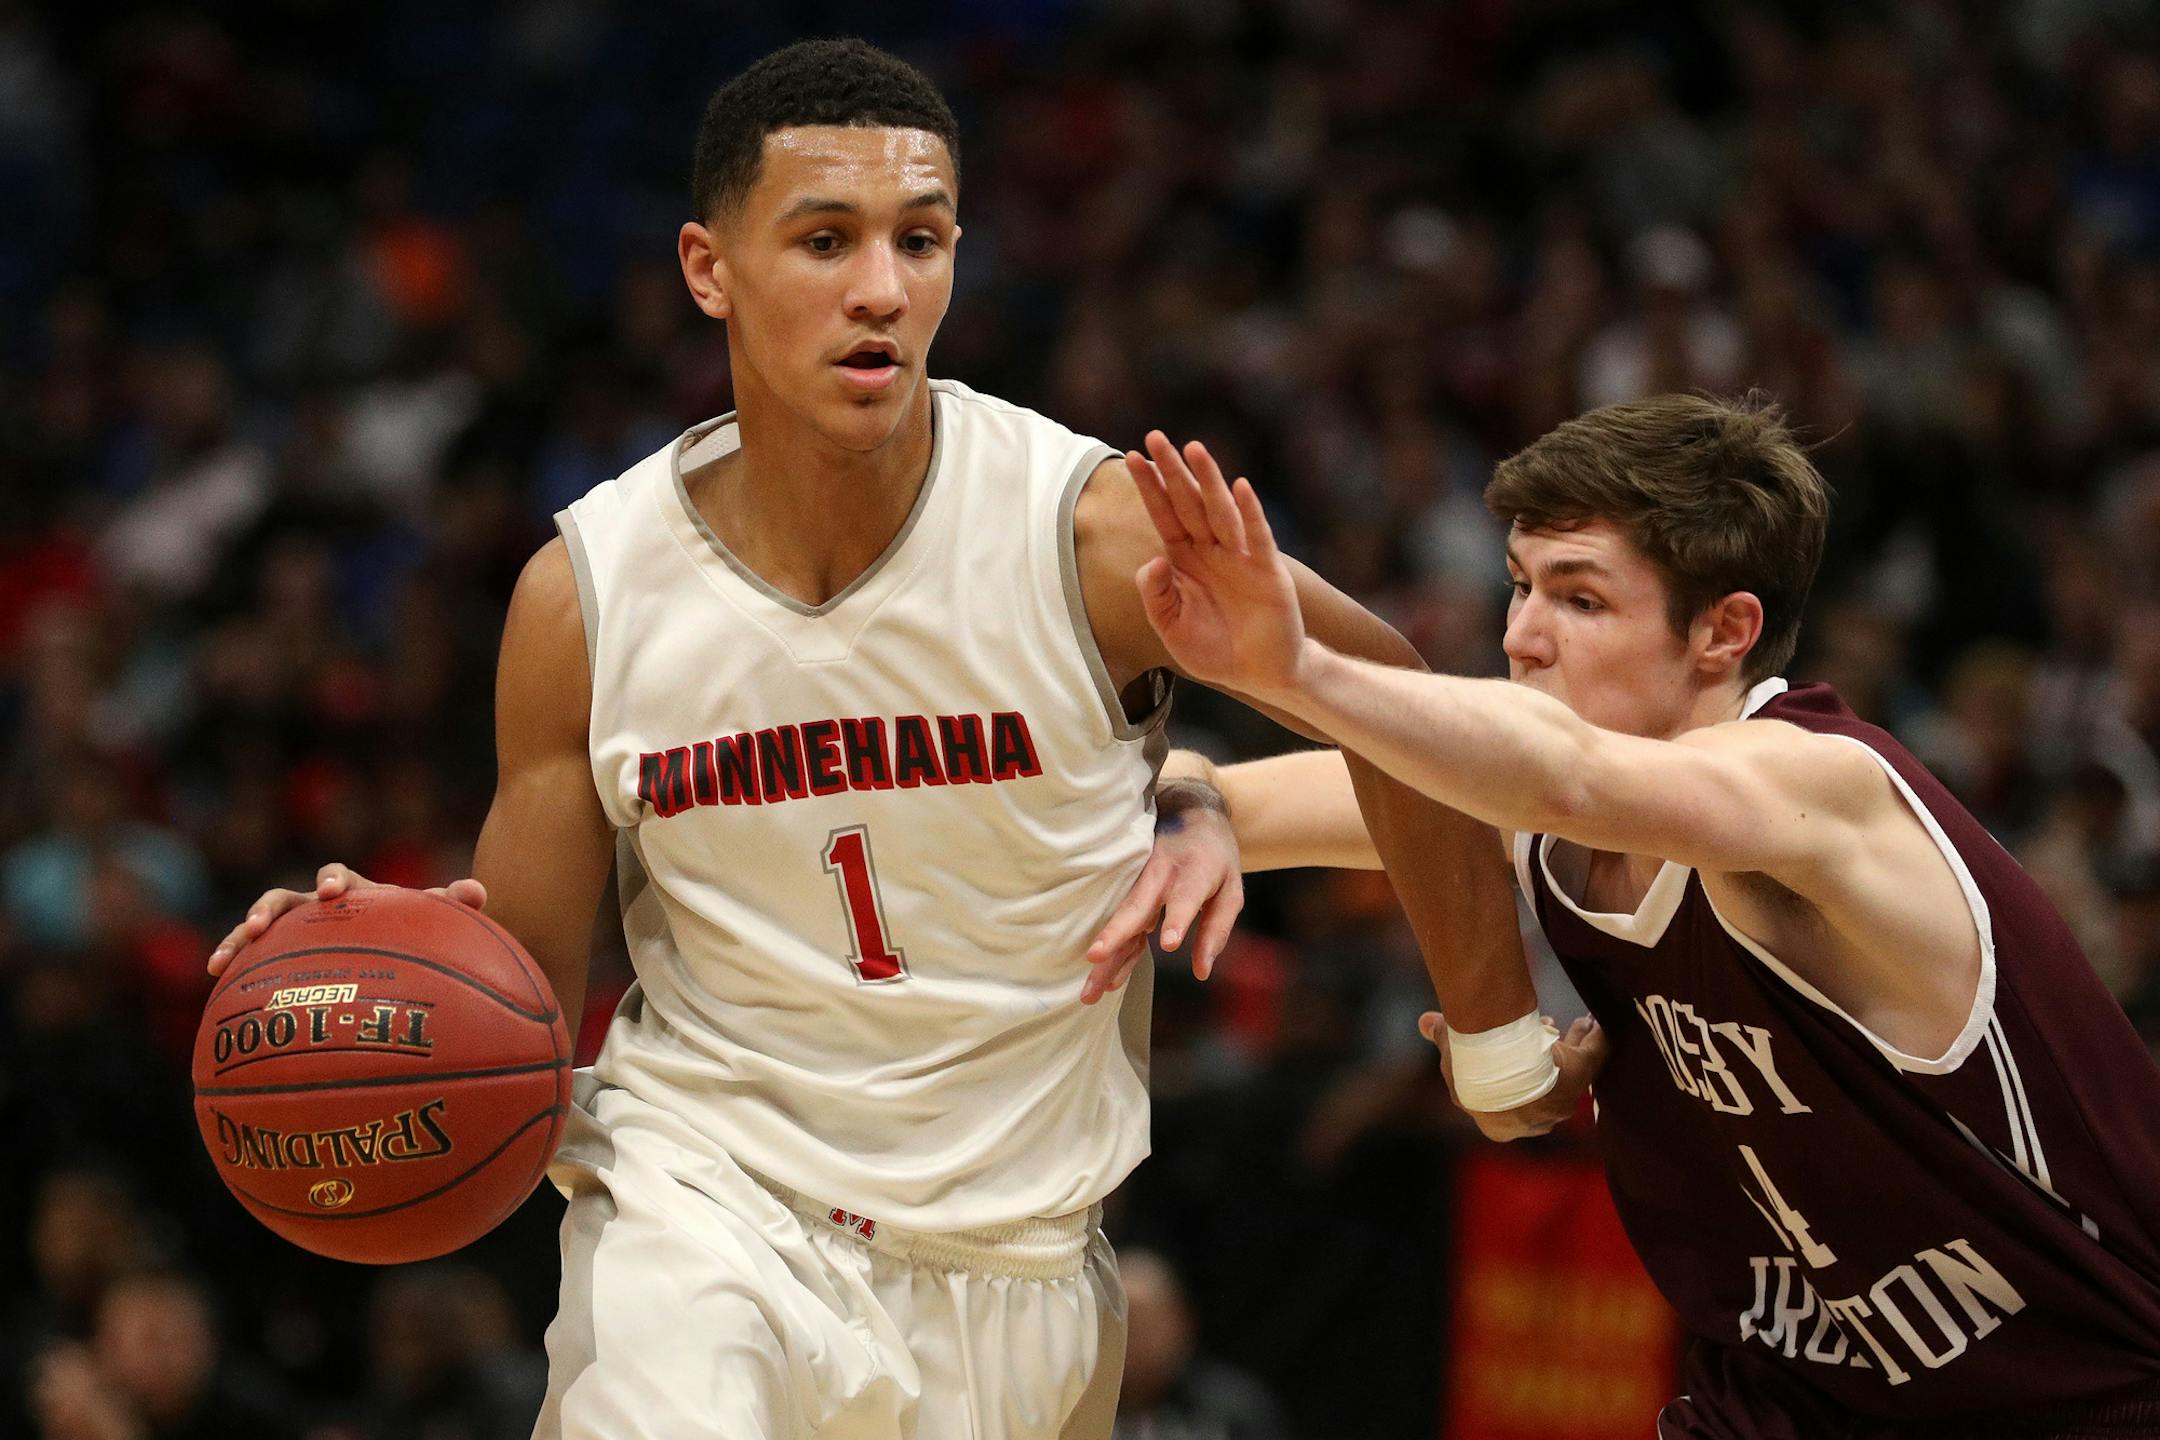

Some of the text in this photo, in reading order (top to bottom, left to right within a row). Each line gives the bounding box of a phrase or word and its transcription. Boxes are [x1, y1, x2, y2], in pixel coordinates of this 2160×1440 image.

[639, 711, 1043, 818] MINNEHAHA
[820, 823, 911, 986] 1
[214, 1006, 433, 1063] TF-1000
[266, 984, 357, 1010] LEGACY
[215, 1097, 452, 1169] SPALDING
[1739, 1238, 2026, 1386] IROTON
